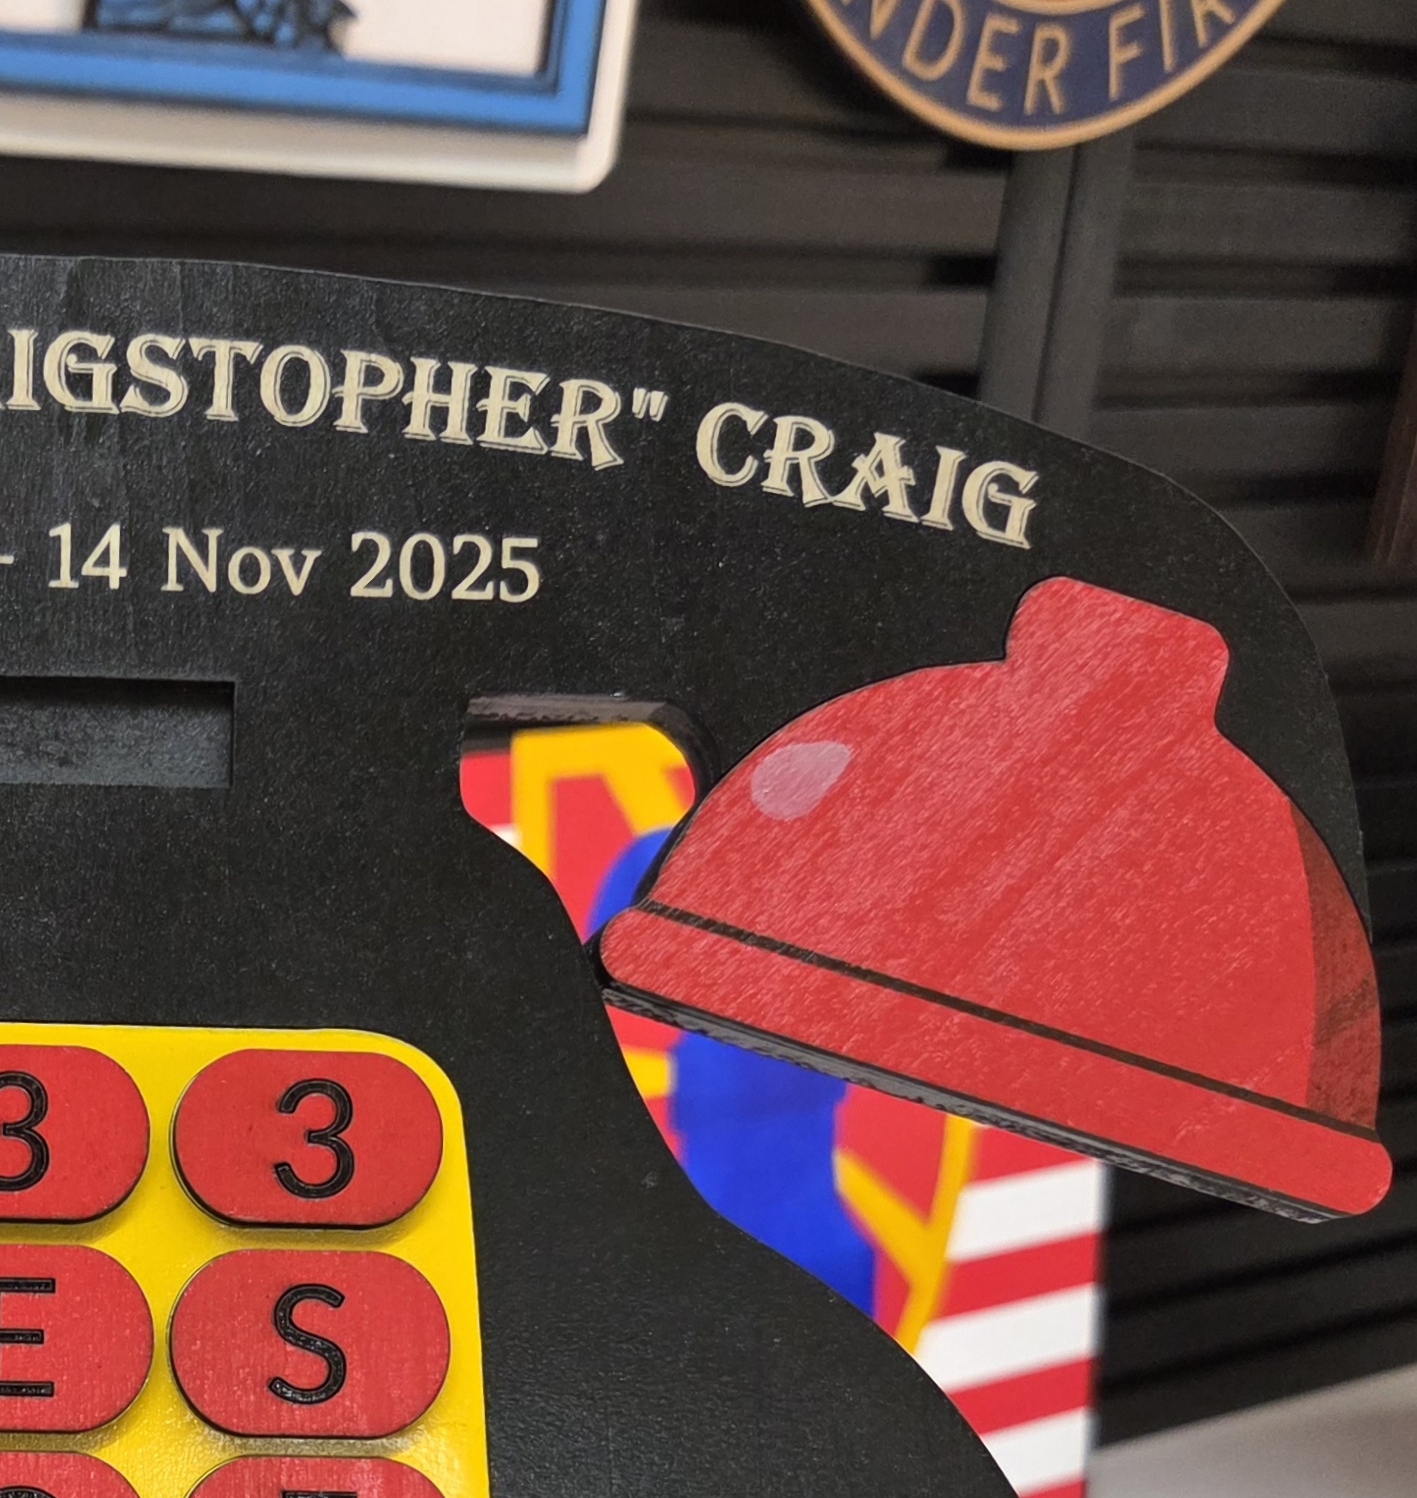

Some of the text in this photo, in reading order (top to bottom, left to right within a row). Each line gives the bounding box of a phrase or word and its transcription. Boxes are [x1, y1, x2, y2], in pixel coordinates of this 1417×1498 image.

[695, 402, 1040, 549] CRAIG
[48, 522, 128, 590] 14
[160, 526, 323, 596] Nov
[349, 531, 542, 603] 2025
[273, 1078, 357, 1199] 3
[267, 1282, 348, 1406] S
